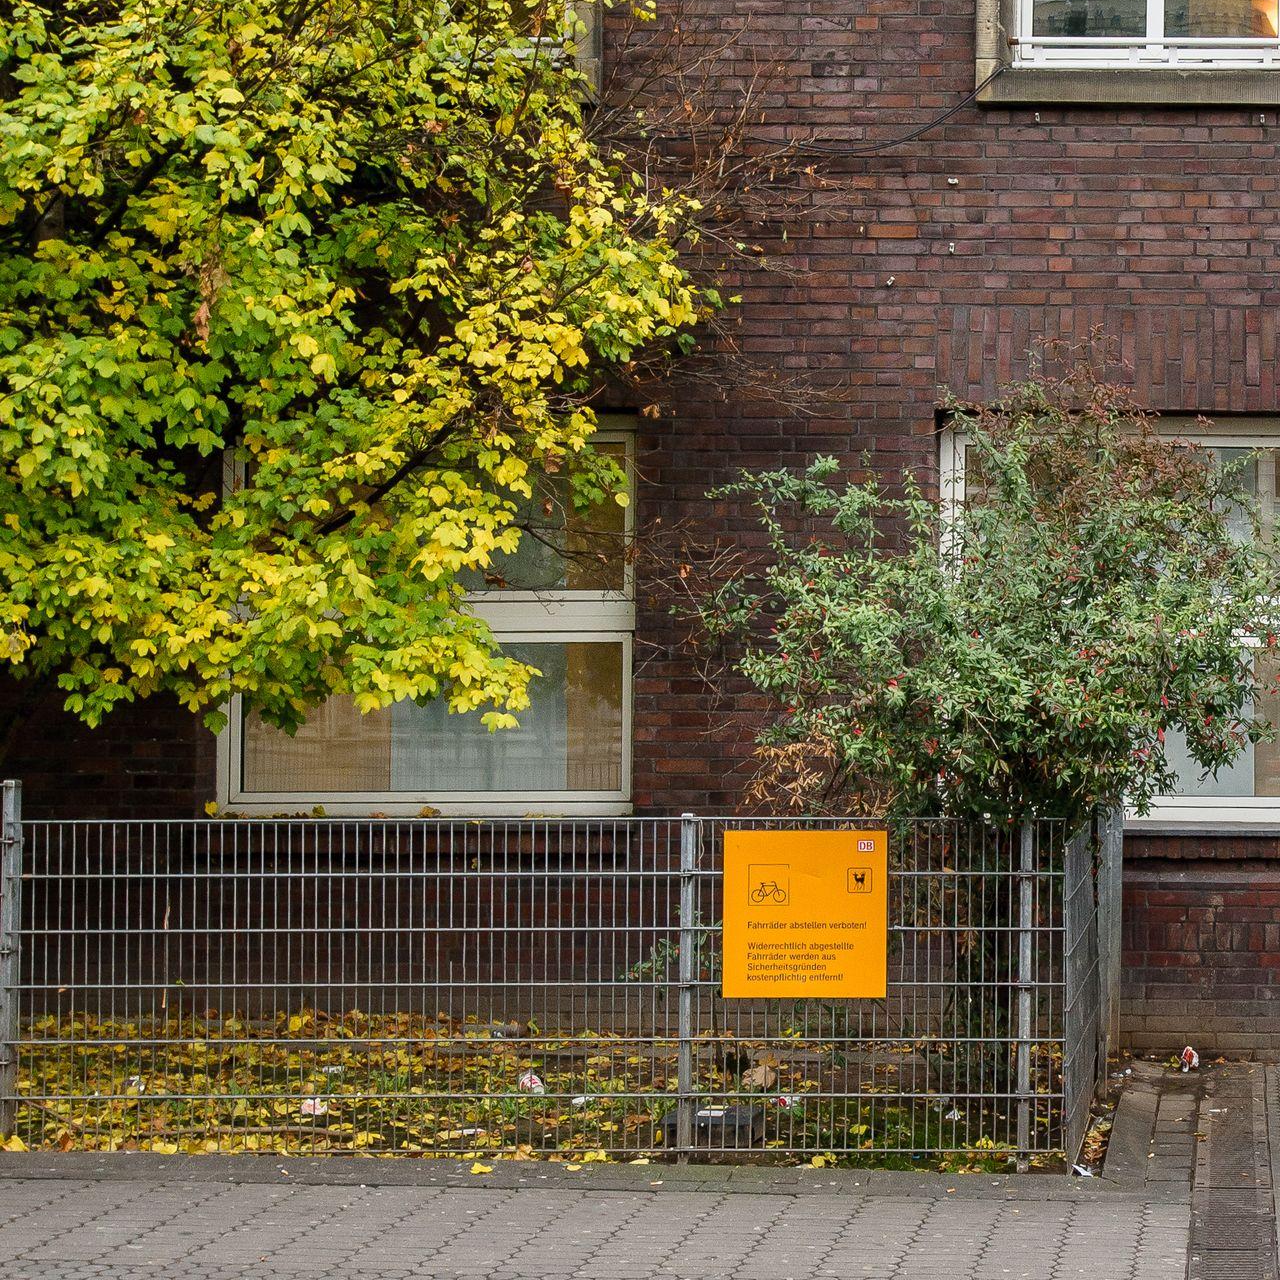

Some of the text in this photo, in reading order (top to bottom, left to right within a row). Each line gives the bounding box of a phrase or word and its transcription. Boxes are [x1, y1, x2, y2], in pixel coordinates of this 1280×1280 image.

[859, 841, 873, 851] DB
[747, 921, 867, 930] Fahrräder abstellen verboten!
[747, 942, 854, 952] Widerrechtlich abgestellte
[747, 952, 837, 961] Fahrräder werden aus
[747, 962, 827, 973] Sicherheitsgründen
[746, 973, 844, 983] kostenpflichtig entfernt!
